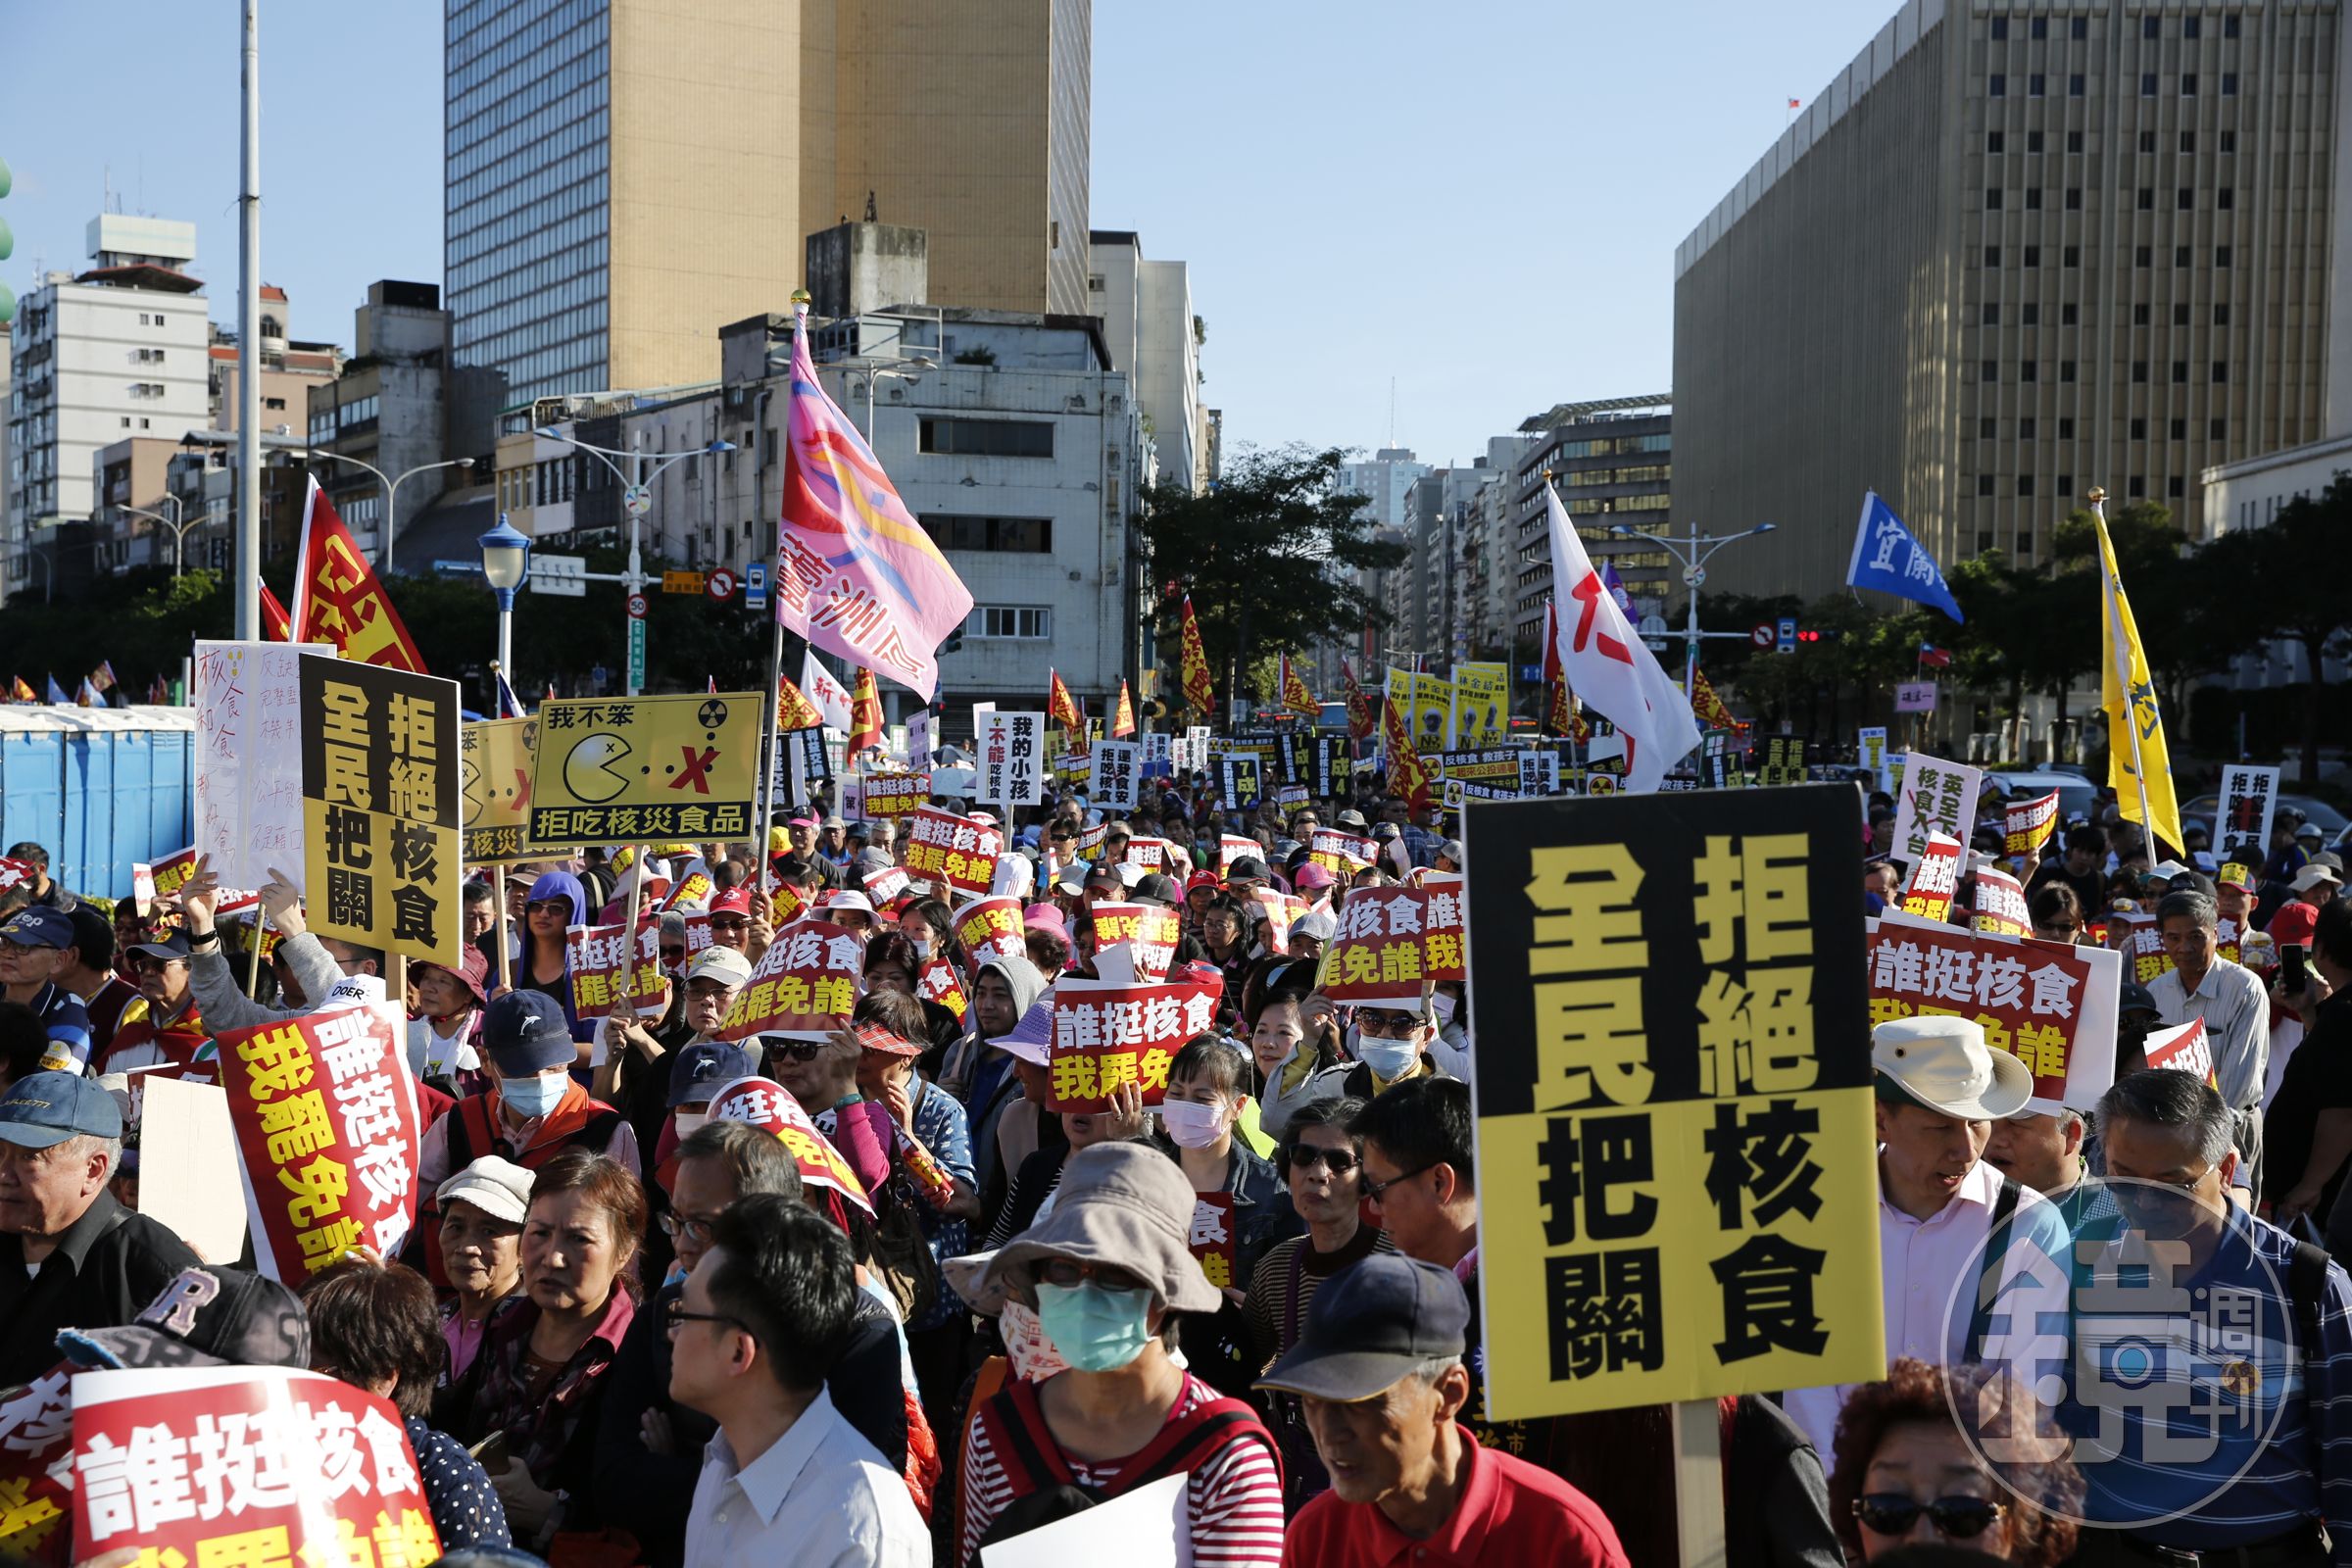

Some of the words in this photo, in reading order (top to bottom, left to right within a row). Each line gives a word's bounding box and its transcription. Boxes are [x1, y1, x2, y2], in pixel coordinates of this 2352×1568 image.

[631, 602, 644, 611] 50
[547, 704, 635, 730] 我不笨
[987, 727, 1006, 800] 不能吃核食
[1009, 715, 1033, 801] 我的小孩
[1099, 748, 1115, 803] 拒吃核食
[1331, 738, 1349, 796] 7成4
[1445, 753, 1478, 766] 反核食
[1482, 750, 1517, 763] 救孩子
[322, 679, 374, 933] 全民把關
[866, 776, 930, 797] 誰挺核食
[1465, 784, 1490, 799] 反核食
[388, 694, 438, 950] 拒絕核食
[536, 805, 745, 838] 拒吃核災食品
[910, 814, 1002, 858] 誰挺核食
[1311, 834, 1379, 860] 誰挺核食
[906, 842, 995, 884] 我罷免誰
[333, 985, 365, 1001] DOER
[1874, 938, 2080, 1019] 誰挺核食
[1054, 991, 1216, 1050] 誰挺核食
[1522, 842, 1666, 1384] 全民把關
[1691, 831, 1832, 1367] 拒絕核食
[134, 1266, 220, 1338] R
[75, 1399, 420, 1543] 誰挺核食
